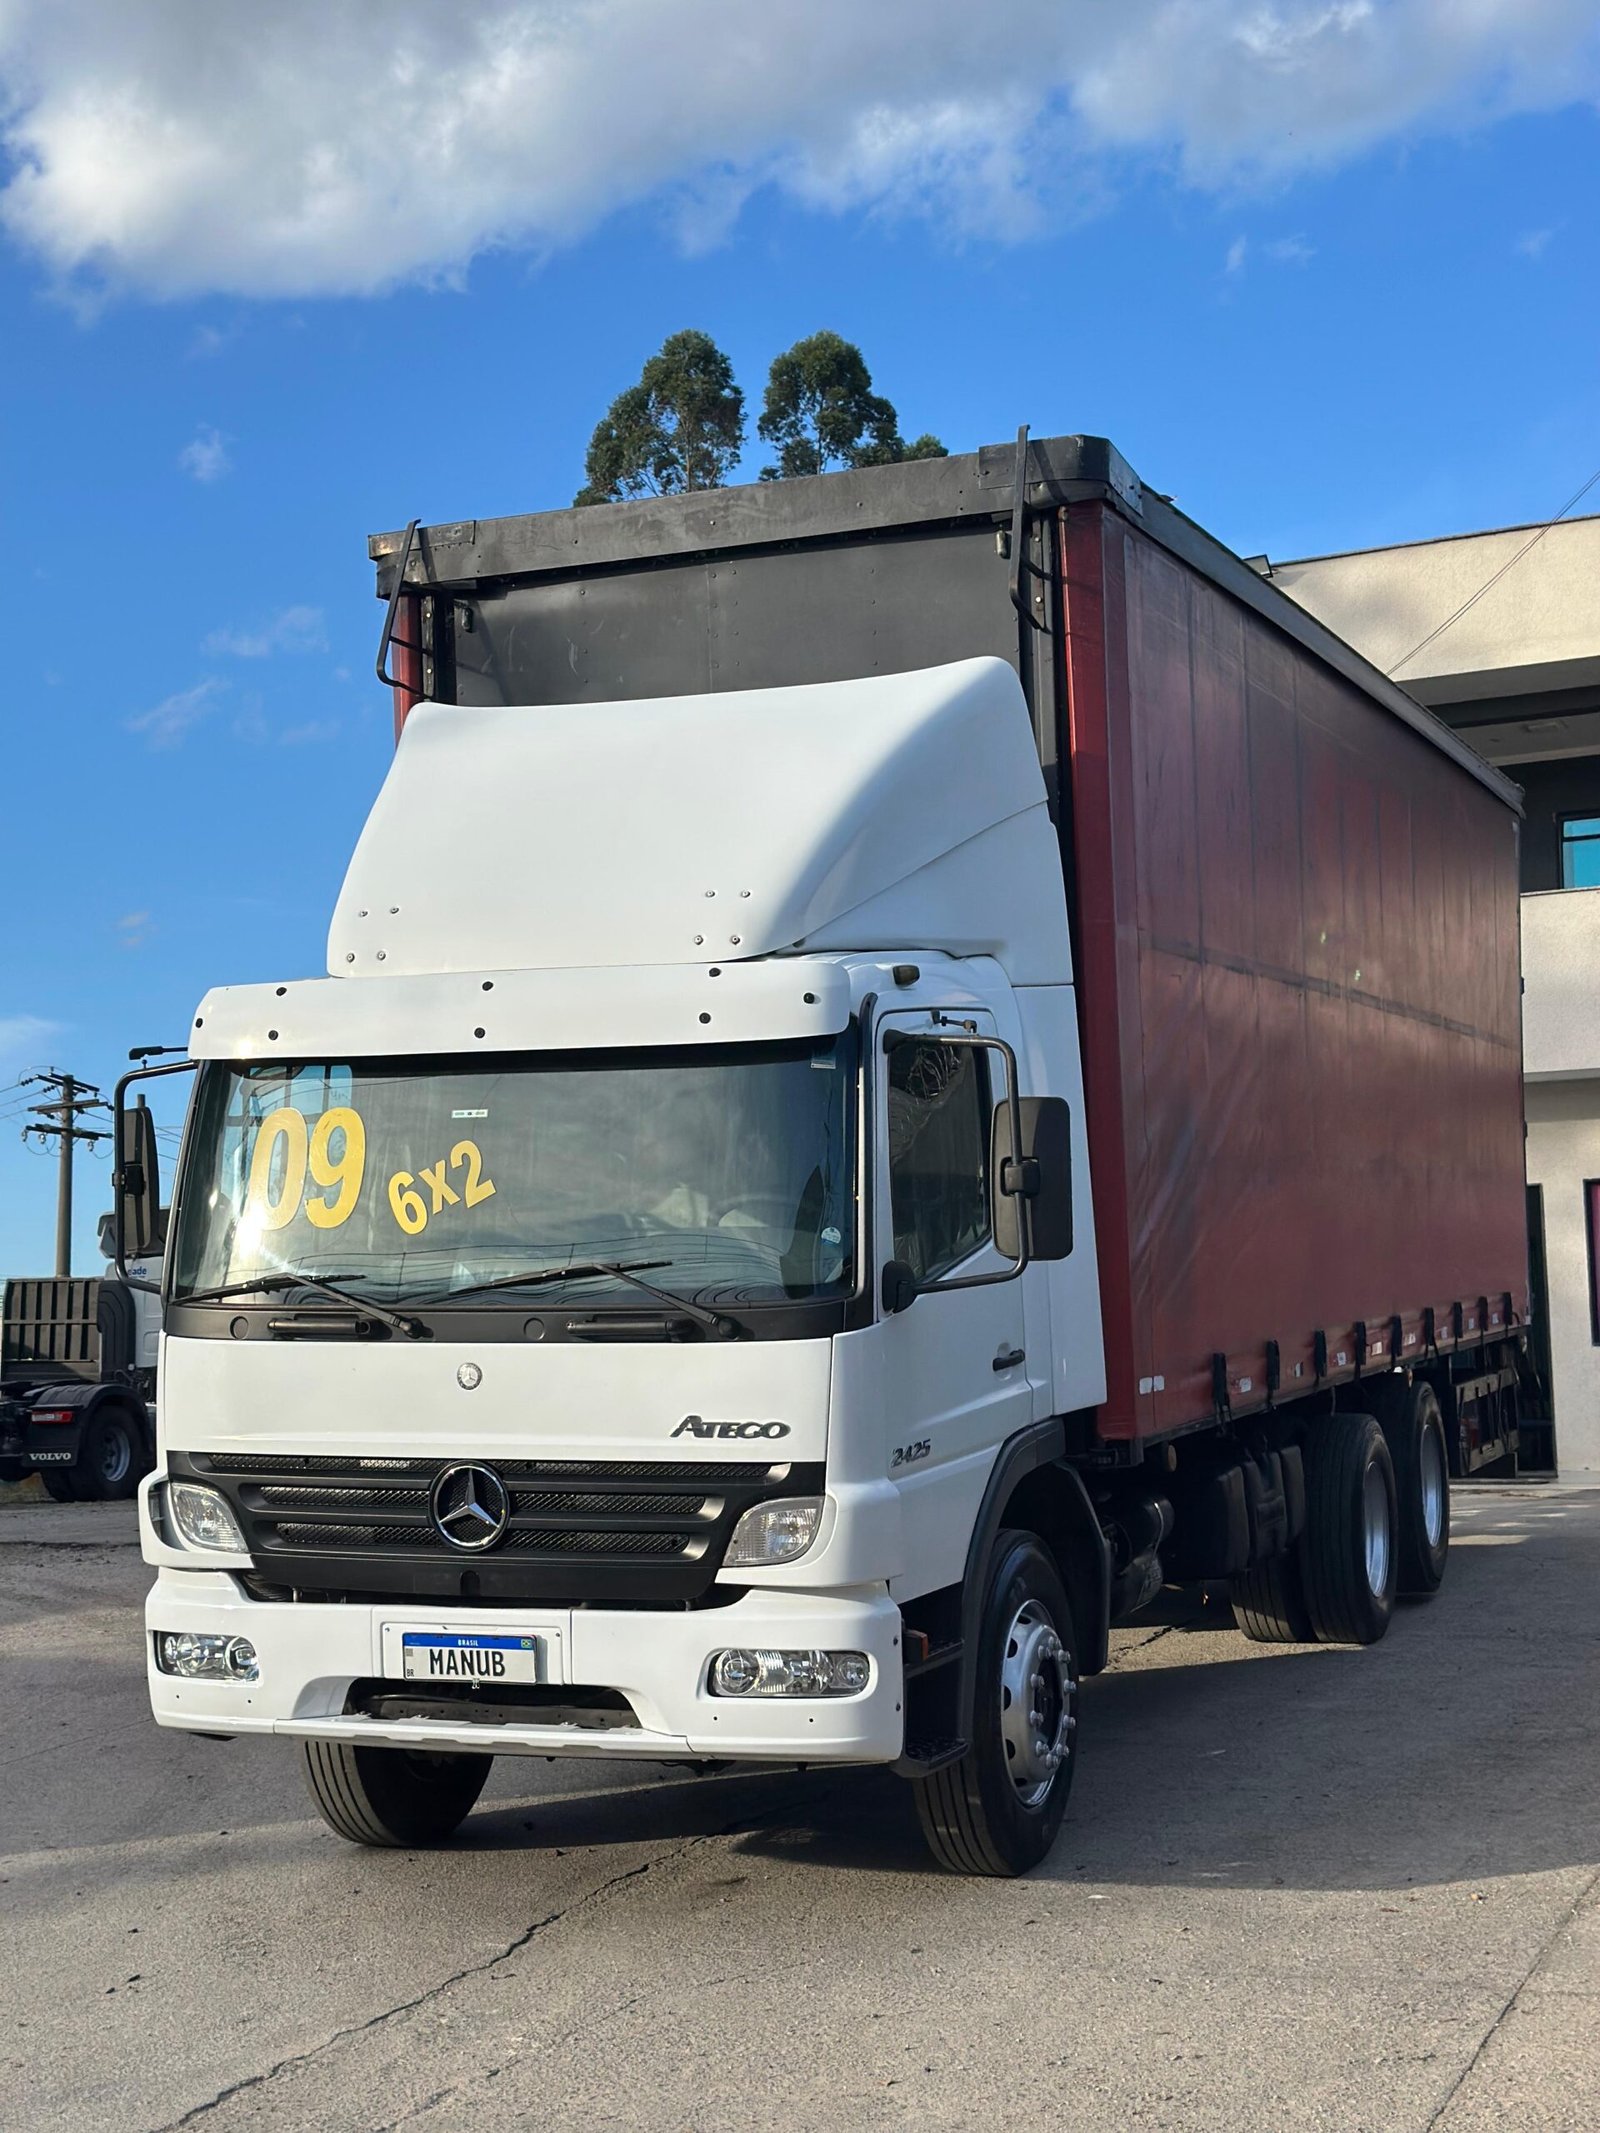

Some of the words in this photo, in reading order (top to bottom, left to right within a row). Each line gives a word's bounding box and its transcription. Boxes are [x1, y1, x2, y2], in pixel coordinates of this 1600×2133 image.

[244, 1106, 366, 1230] 09
[29, 1452, 72, 1460] VOLVO
[891, 1438, 931, 1468] 2425
[457, 1639, 479, 1647] BRASIL
[429, 1648, 506, 1677] MANUB
[406, 1668, 415, 1678] BR
